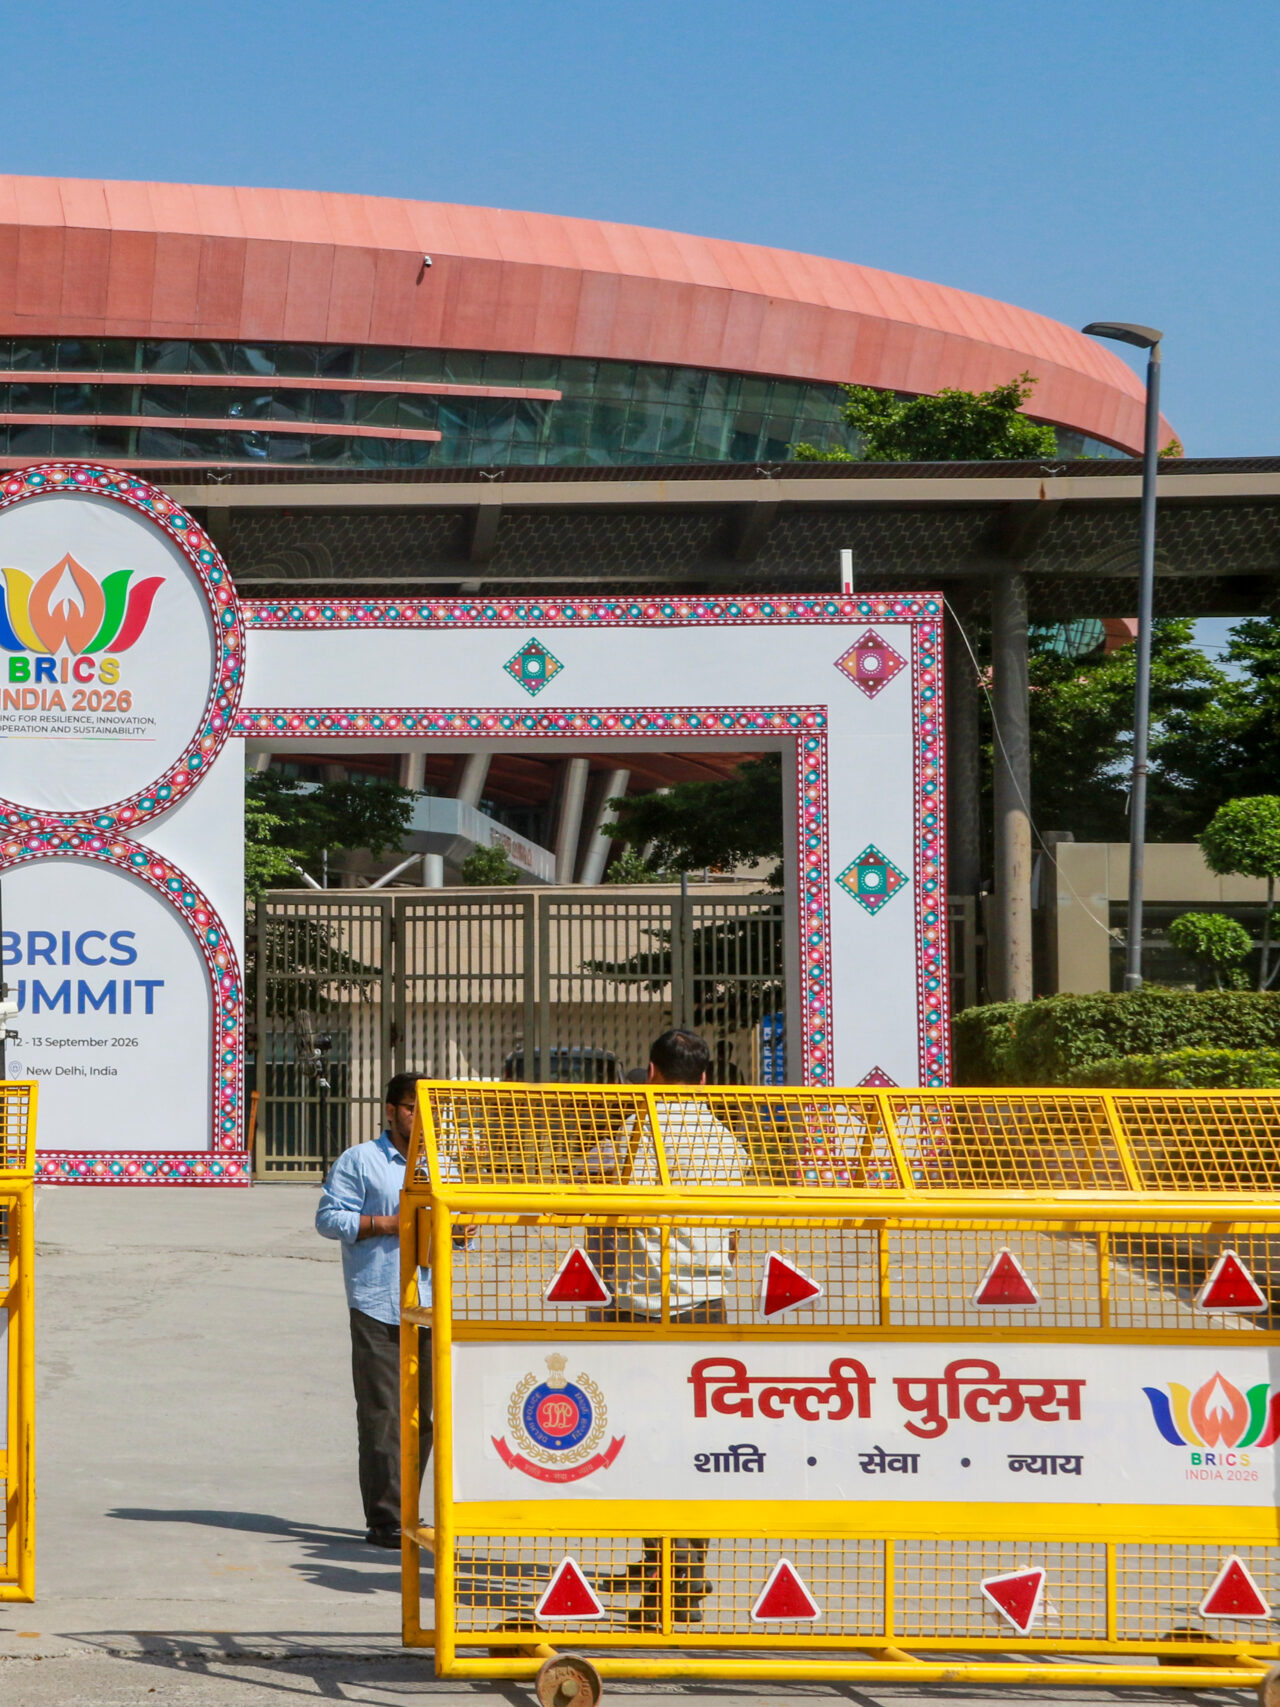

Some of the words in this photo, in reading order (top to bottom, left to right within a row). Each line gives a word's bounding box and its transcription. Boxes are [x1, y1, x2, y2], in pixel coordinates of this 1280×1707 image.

[9, 656, 120, 685] BRICS
[72, 689, 133, 712] 2026
[18, 714, 38, 723] FOR
[40, 715, 95, 724] RESILIENCE,
[96, 716, 157, 726] INNOVATION,
[50, 725, 72, 734] AND
[73, 726, 146, 735] SUSTAINABILITY
[2, 930, 138, 966] BRICS
[13, 1038, 23, 1047] 12
[32, 1038, 43, 1047] 13
[45, 1037, 108, 1049] September
[110, 1037, 139, 1047] 2026
[26, 1066, 53, 1076] New
[56, 1065, 87, 1077] Delhi,
[89, 1065, 118, 1076] India
[687, 1357, 876, 1421] दिल्ली
[892, 1358, 1086, 1439] पुलिस
[694, 1443, 766, 1473] शांति
[858, 1445, 920, 1474] सेवा
[1007, 1454, 1084, 1475] न्याय
[1191, 1452, 1251, 1467] BRICS
[1185, 1469, 1224, 1481] INDIA
[1227, 1470, 1259, 1482] 2026
